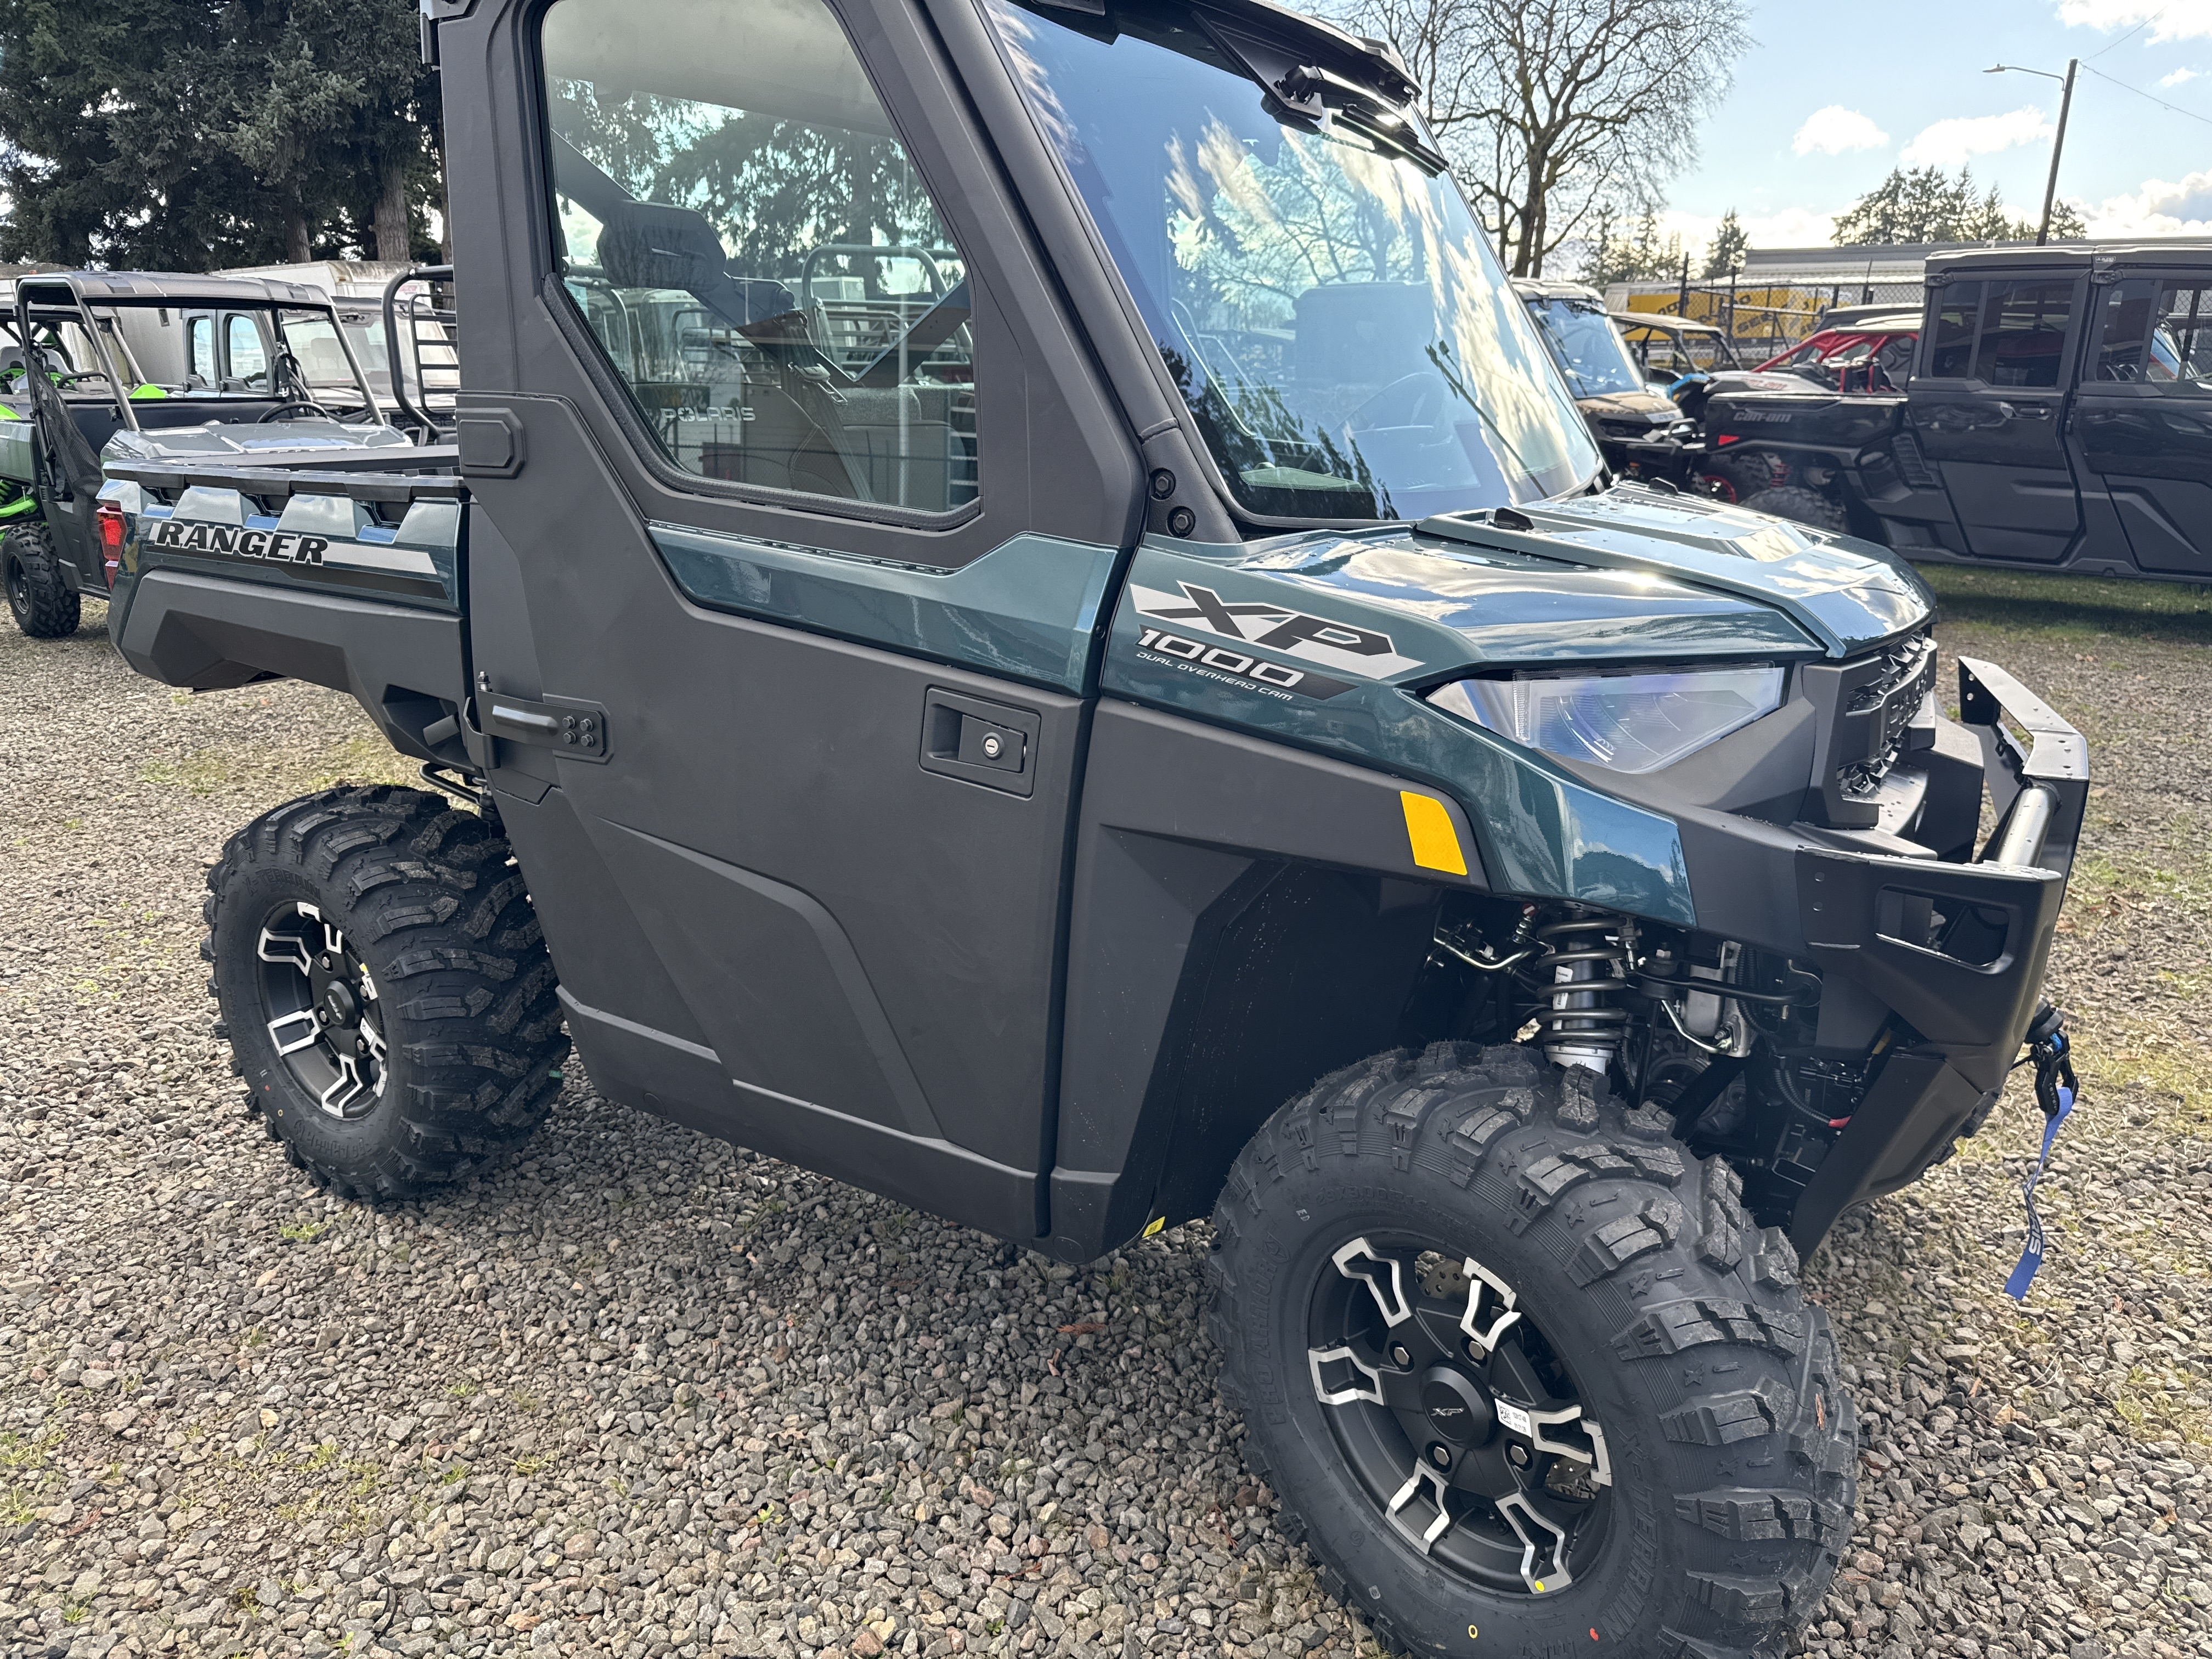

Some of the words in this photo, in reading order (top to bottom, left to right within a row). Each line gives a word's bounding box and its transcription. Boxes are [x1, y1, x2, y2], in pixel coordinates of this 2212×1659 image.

[660, 407, 756, 423] POLARIS
[156, 521, 328, 565] RANGER
[1138, 583, 1395, 657] XP
[1136, 651, 1173, 667] DUAL
[1177, 663, 1257, 691] OVERHEAD
[1257, 686, 1295, 701] CAM
[1137, 629, 1305, 688] 1000
[1430, 1407, 1465, 1417] XP
